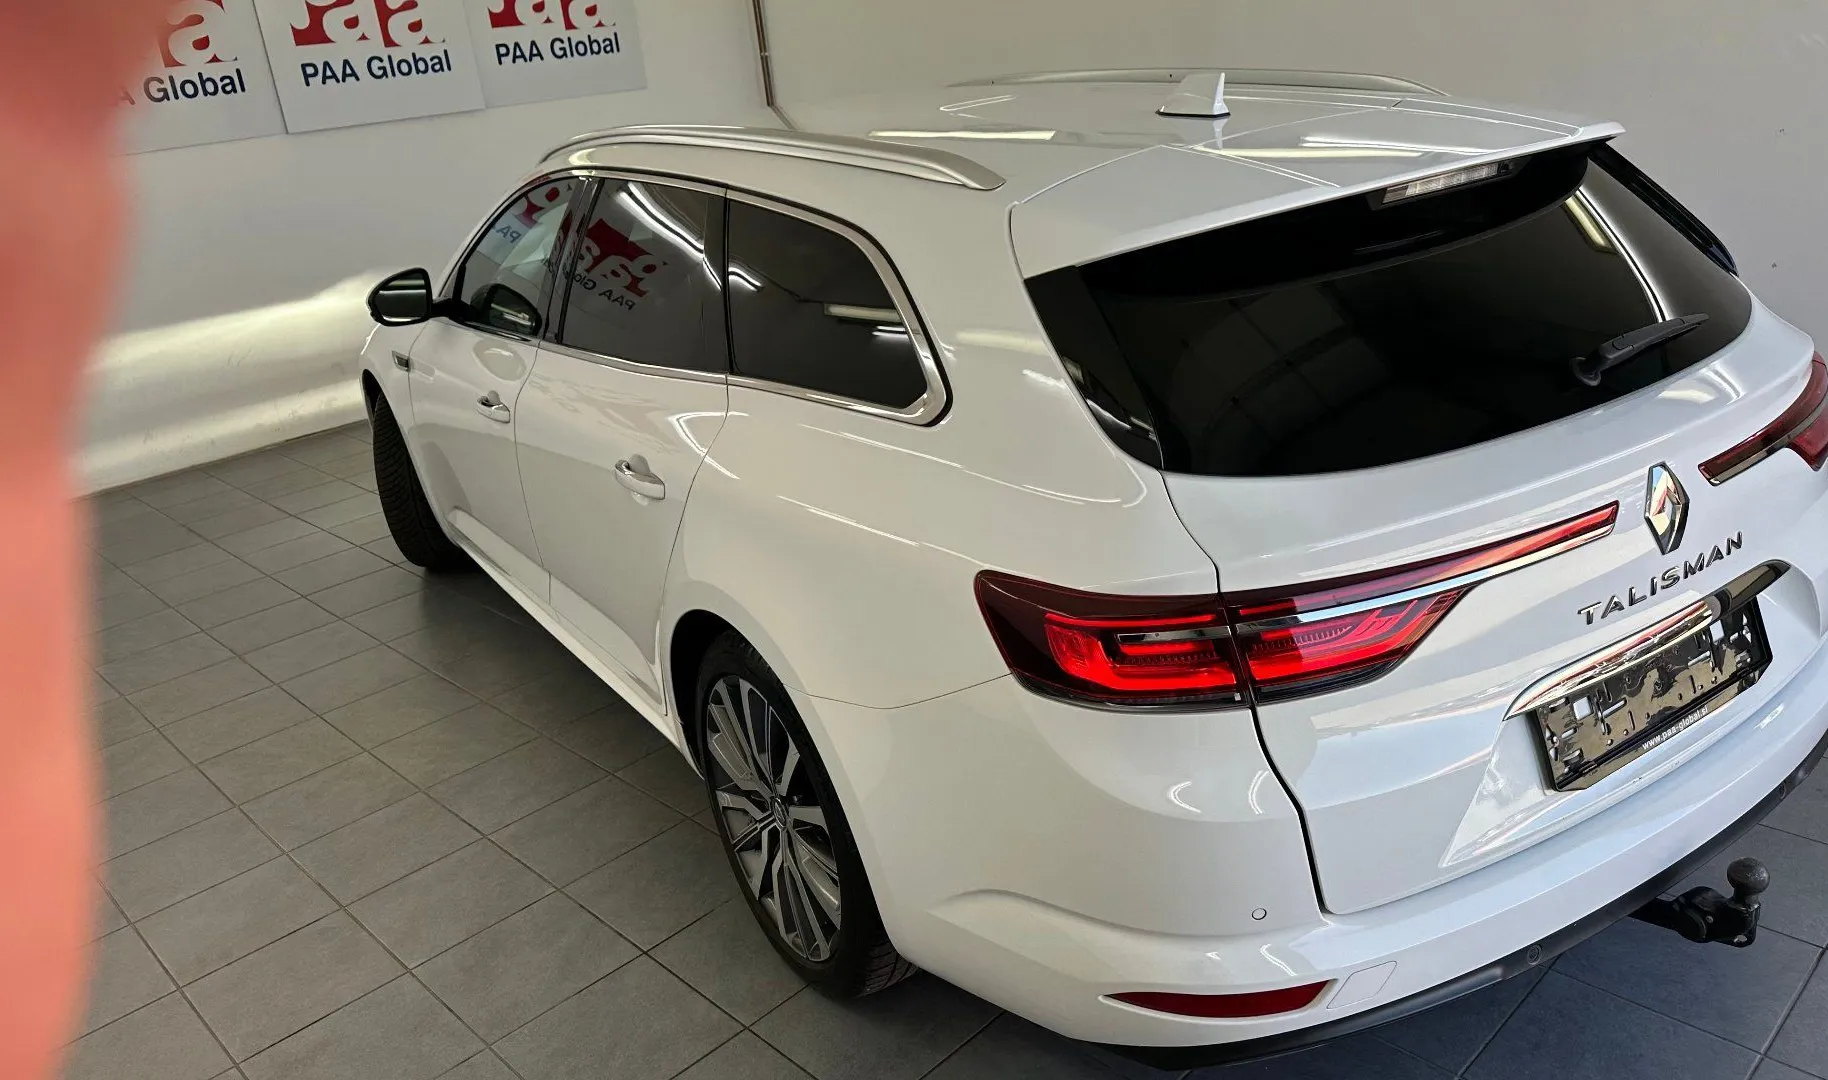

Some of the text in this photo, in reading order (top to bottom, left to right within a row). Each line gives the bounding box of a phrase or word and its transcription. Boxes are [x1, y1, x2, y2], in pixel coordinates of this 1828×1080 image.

[495, 32, 620, 65] PAA Global
[143, 68, 246, 103] Global
[300, 49, 452, 87] PAA Global
[1577, 531, 1743, 625] TALISMAN
[1642, 705, 1708, 750] www.paa-global.si
